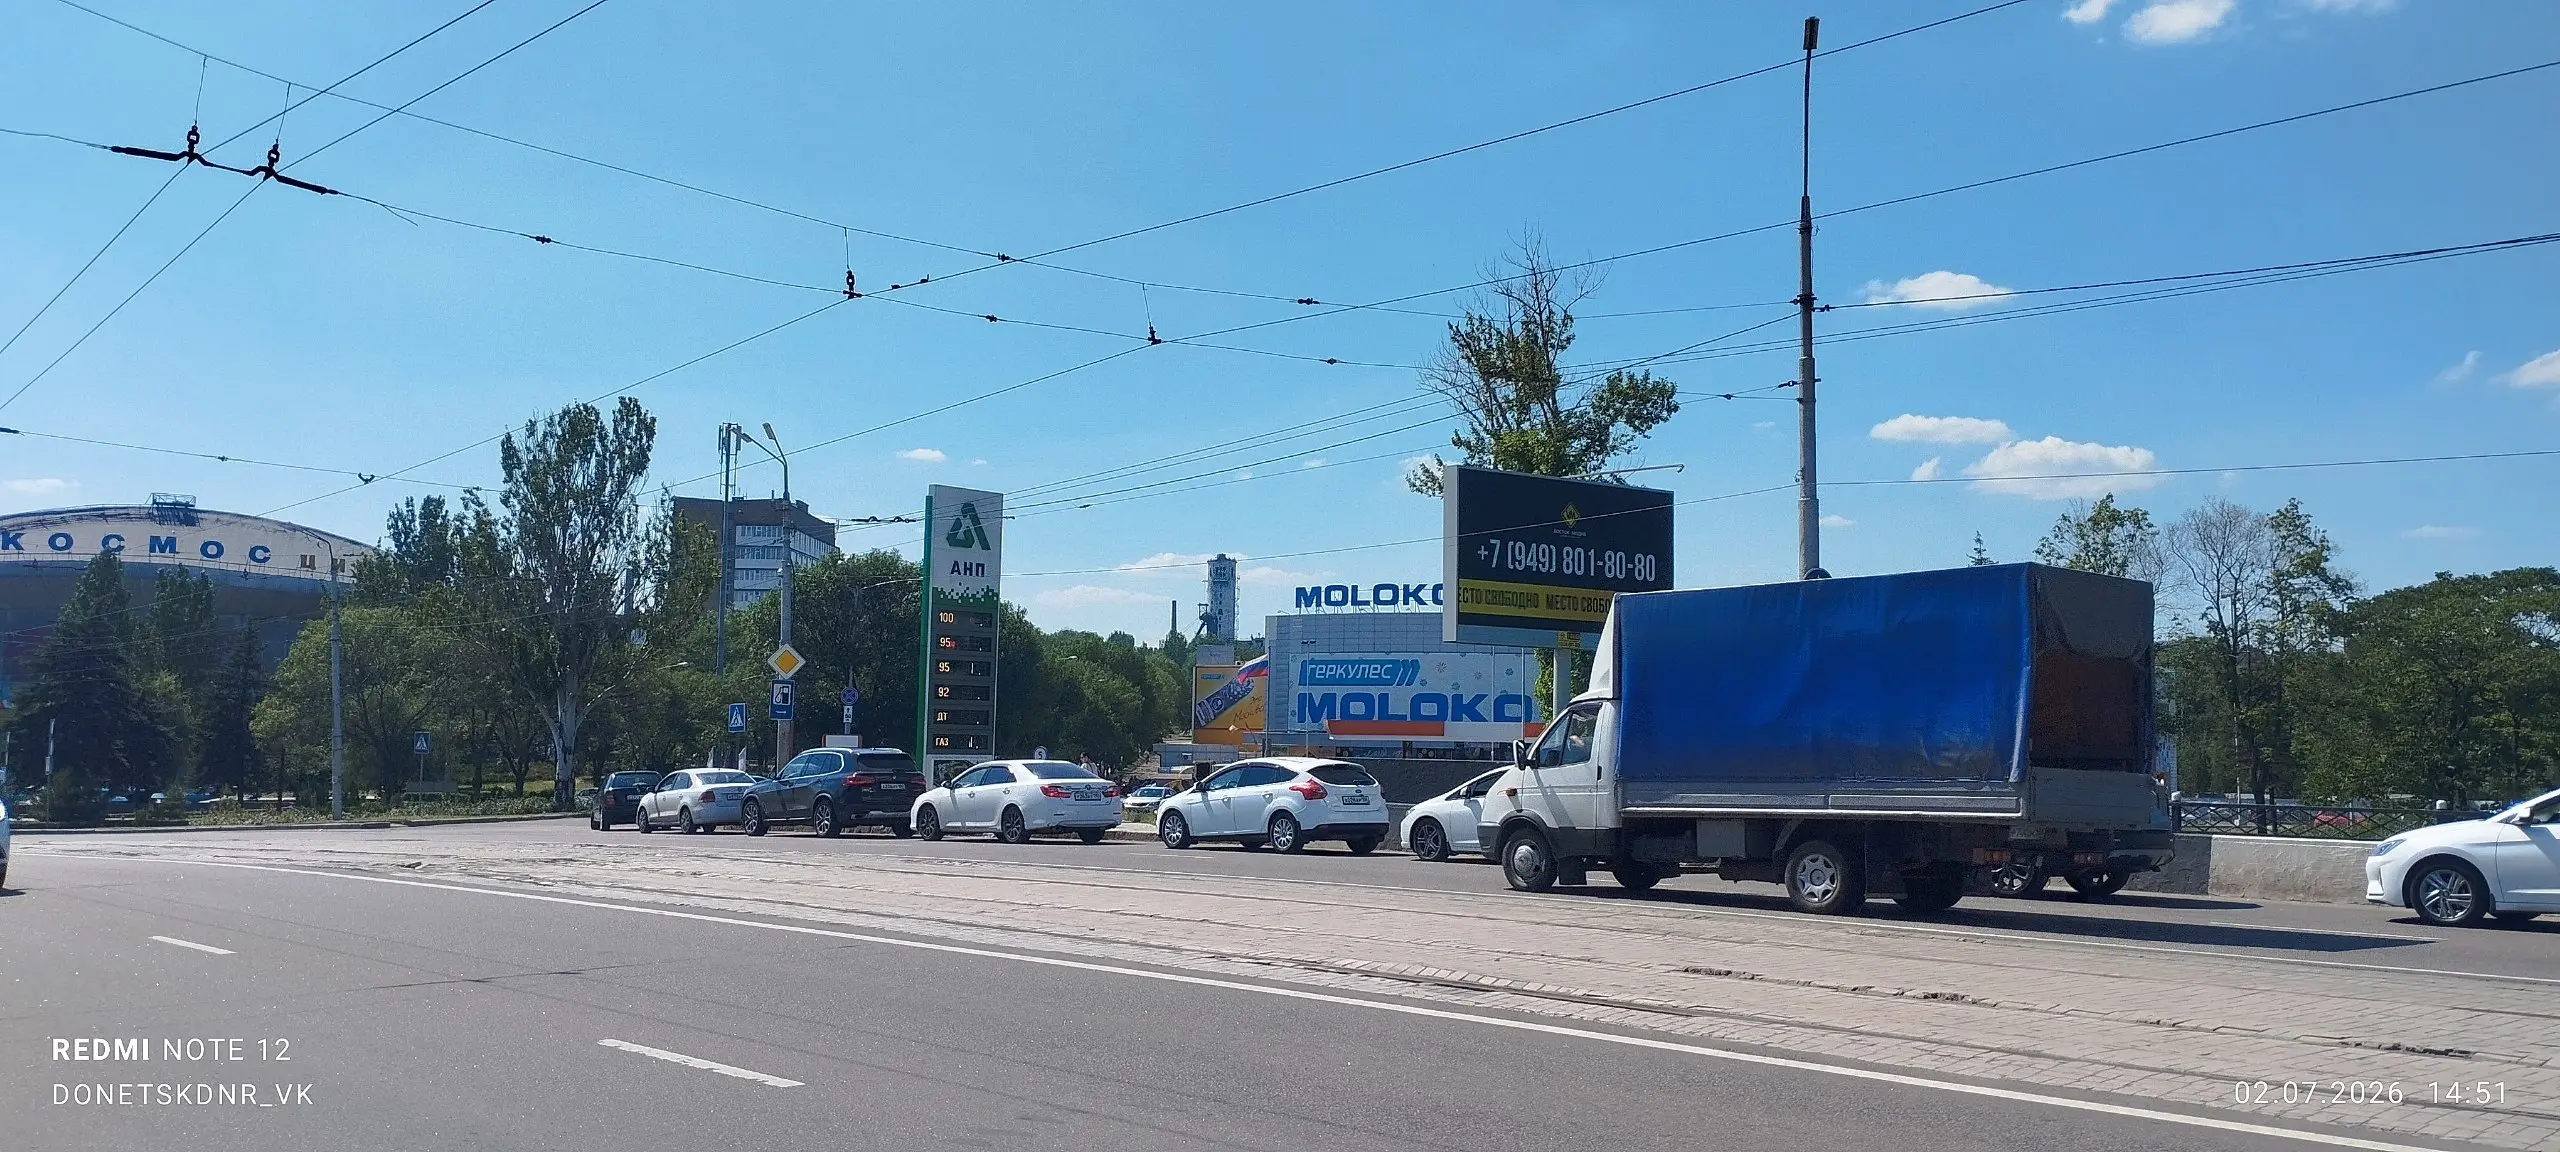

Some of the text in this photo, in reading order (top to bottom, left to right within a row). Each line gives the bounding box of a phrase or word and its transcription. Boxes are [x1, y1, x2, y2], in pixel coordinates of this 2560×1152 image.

[1, 532, 271, 564] КОСМОС
[1478, 539, 1656, 582] +7 (949) 801-80-80
[951, 561, 985, 578] АНП
[1546, 593, 1579, 612] МЕСТО
[940, 612, 954, 623] 100
[940, 637, 951, 647] 95
[939, 662, 950, 672] 95
[938, 687, 949, 697] 92
[1297, 692, 1533, 723] MOLOKO
[936, 712, 948, 721] ДТ
[935, 737, 949, 746] ГАЗ
